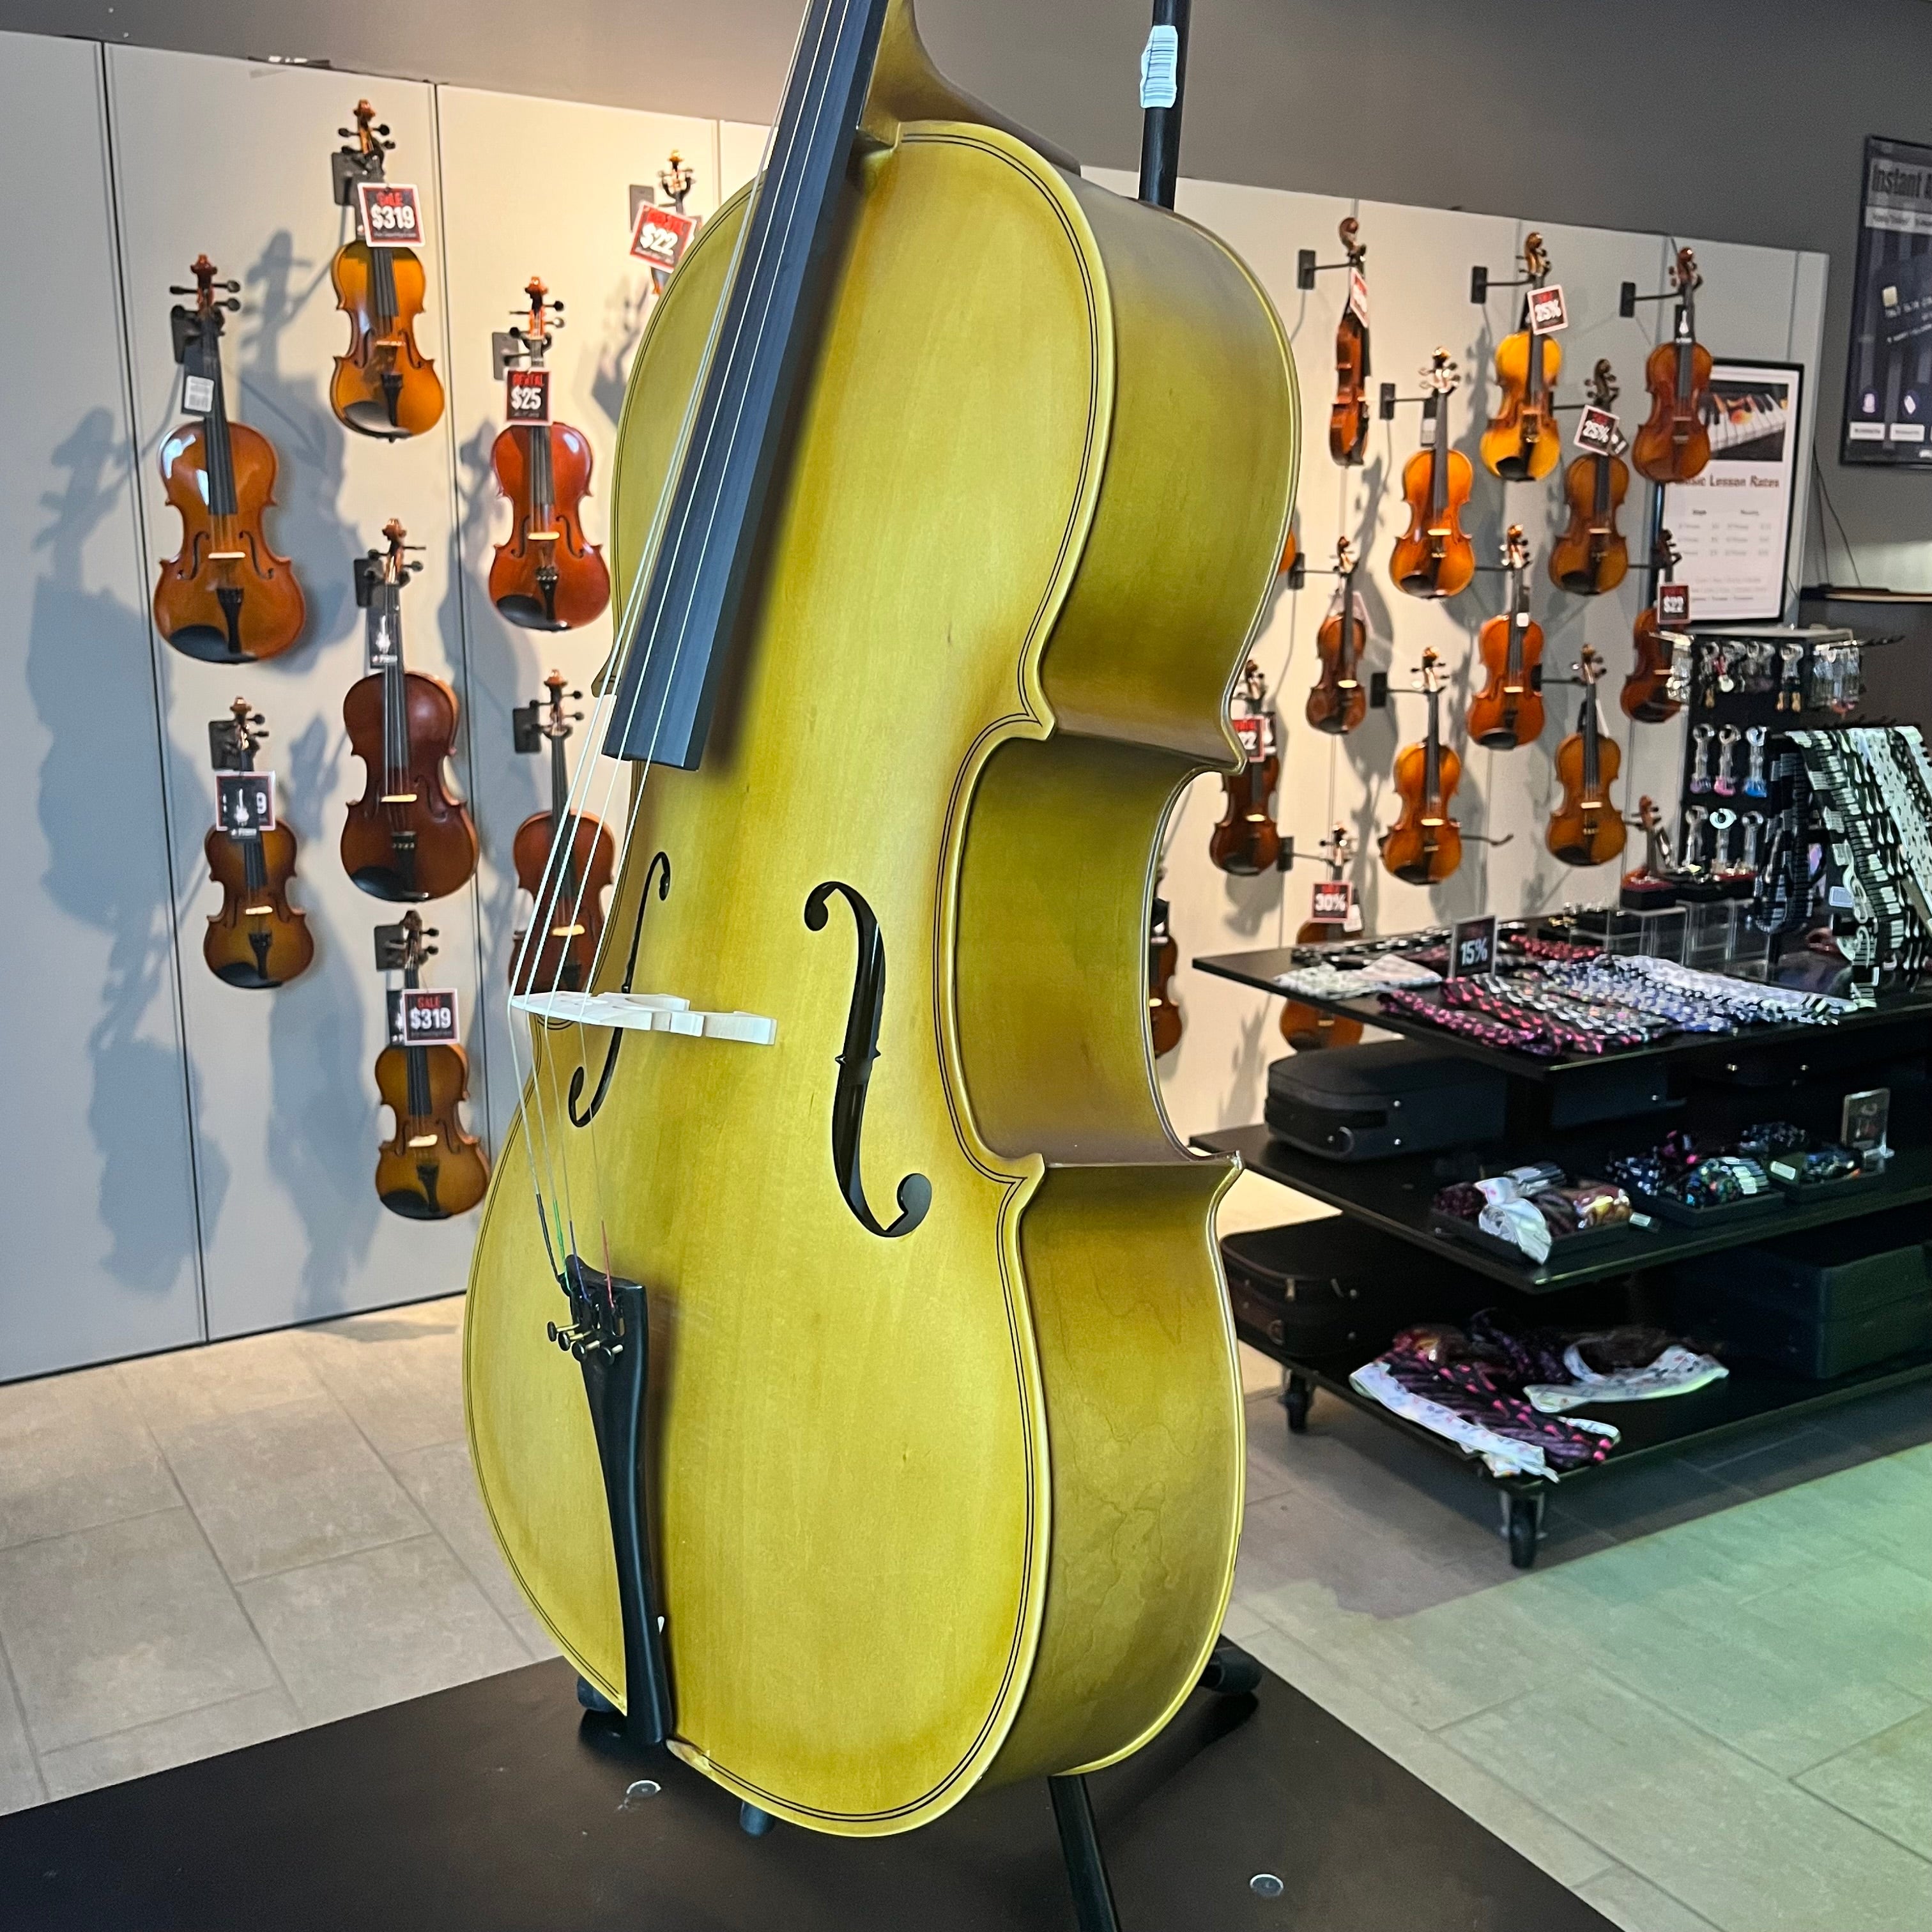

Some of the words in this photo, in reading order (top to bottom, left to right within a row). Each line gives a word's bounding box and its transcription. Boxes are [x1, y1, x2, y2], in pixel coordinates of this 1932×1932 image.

[1872, 164, 1922, 198] Instant
[371, 203, 415, 230] $319
[640, 222, 678, 256] $22
[511, 384, 542, 410] $25
[1583, 420, 1609, 443] 25%
[1709, 473, 1745, 487] Lesson
[1751, 475, 1780, 487] Rates
[1238, 730, 1257, 749] 22
[1315, 893, 1346, 912] 30%
[1460, 936, 1488, 966] 15%
[417, 996, 440, 1009] SALE
[410, 1007, 451, 1030] $319
